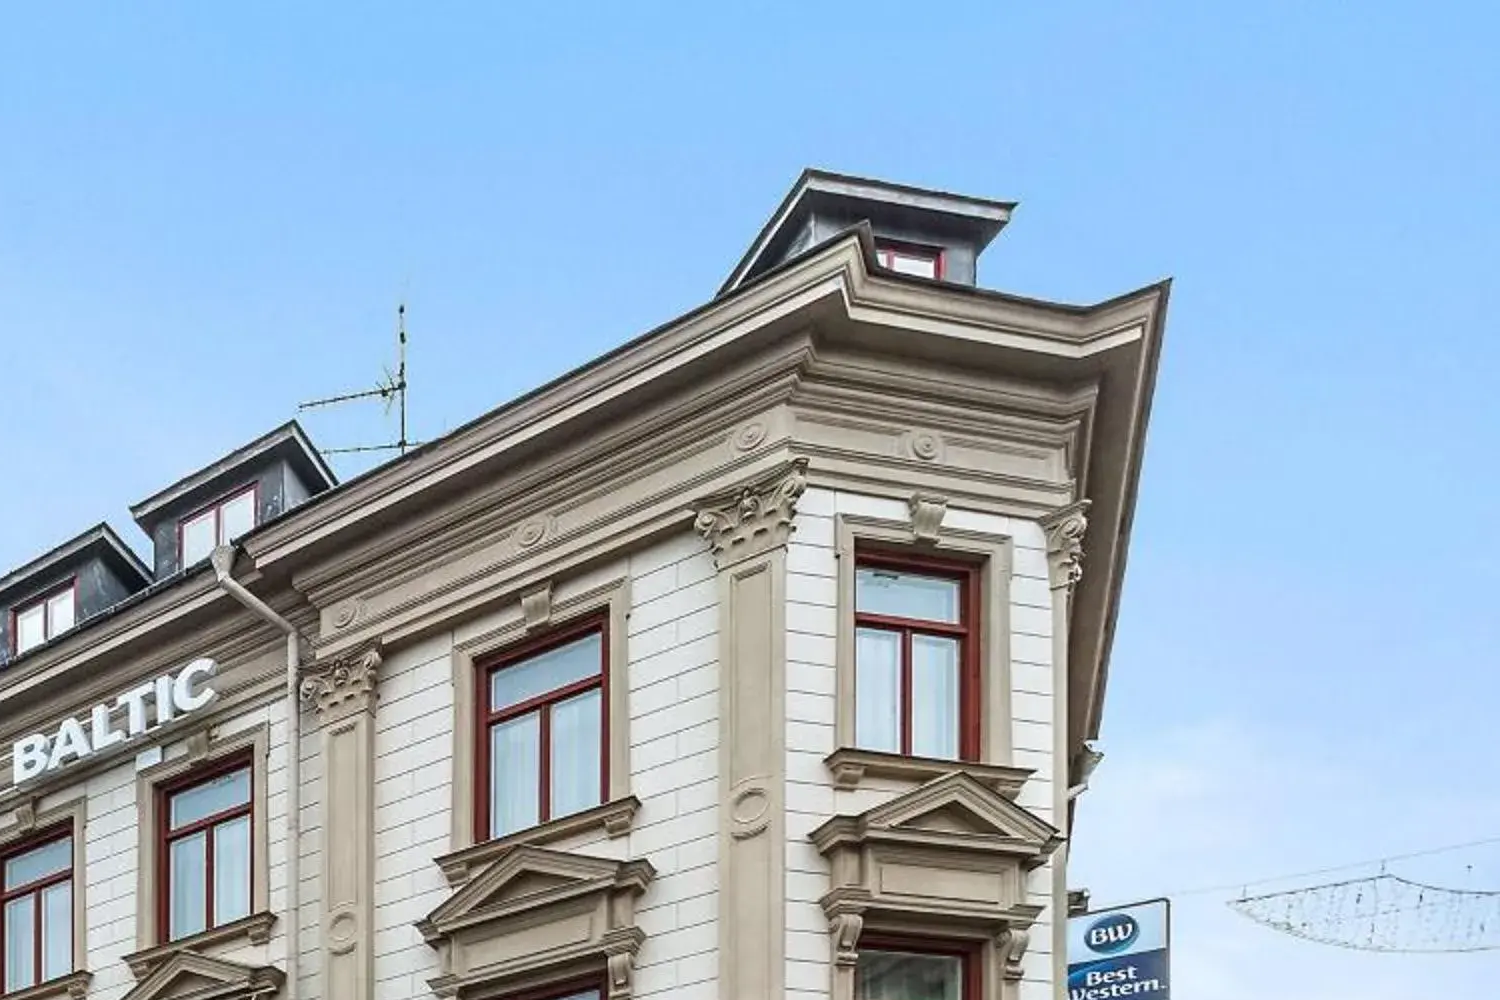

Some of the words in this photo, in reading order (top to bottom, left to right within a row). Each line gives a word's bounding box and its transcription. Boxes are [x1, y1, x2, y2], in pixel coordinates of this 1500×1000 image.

[13, 657, 220, 784] BALTIC
[1091, 923, 1133, 946] BW
[1086, 965, 1138, 986] Best
